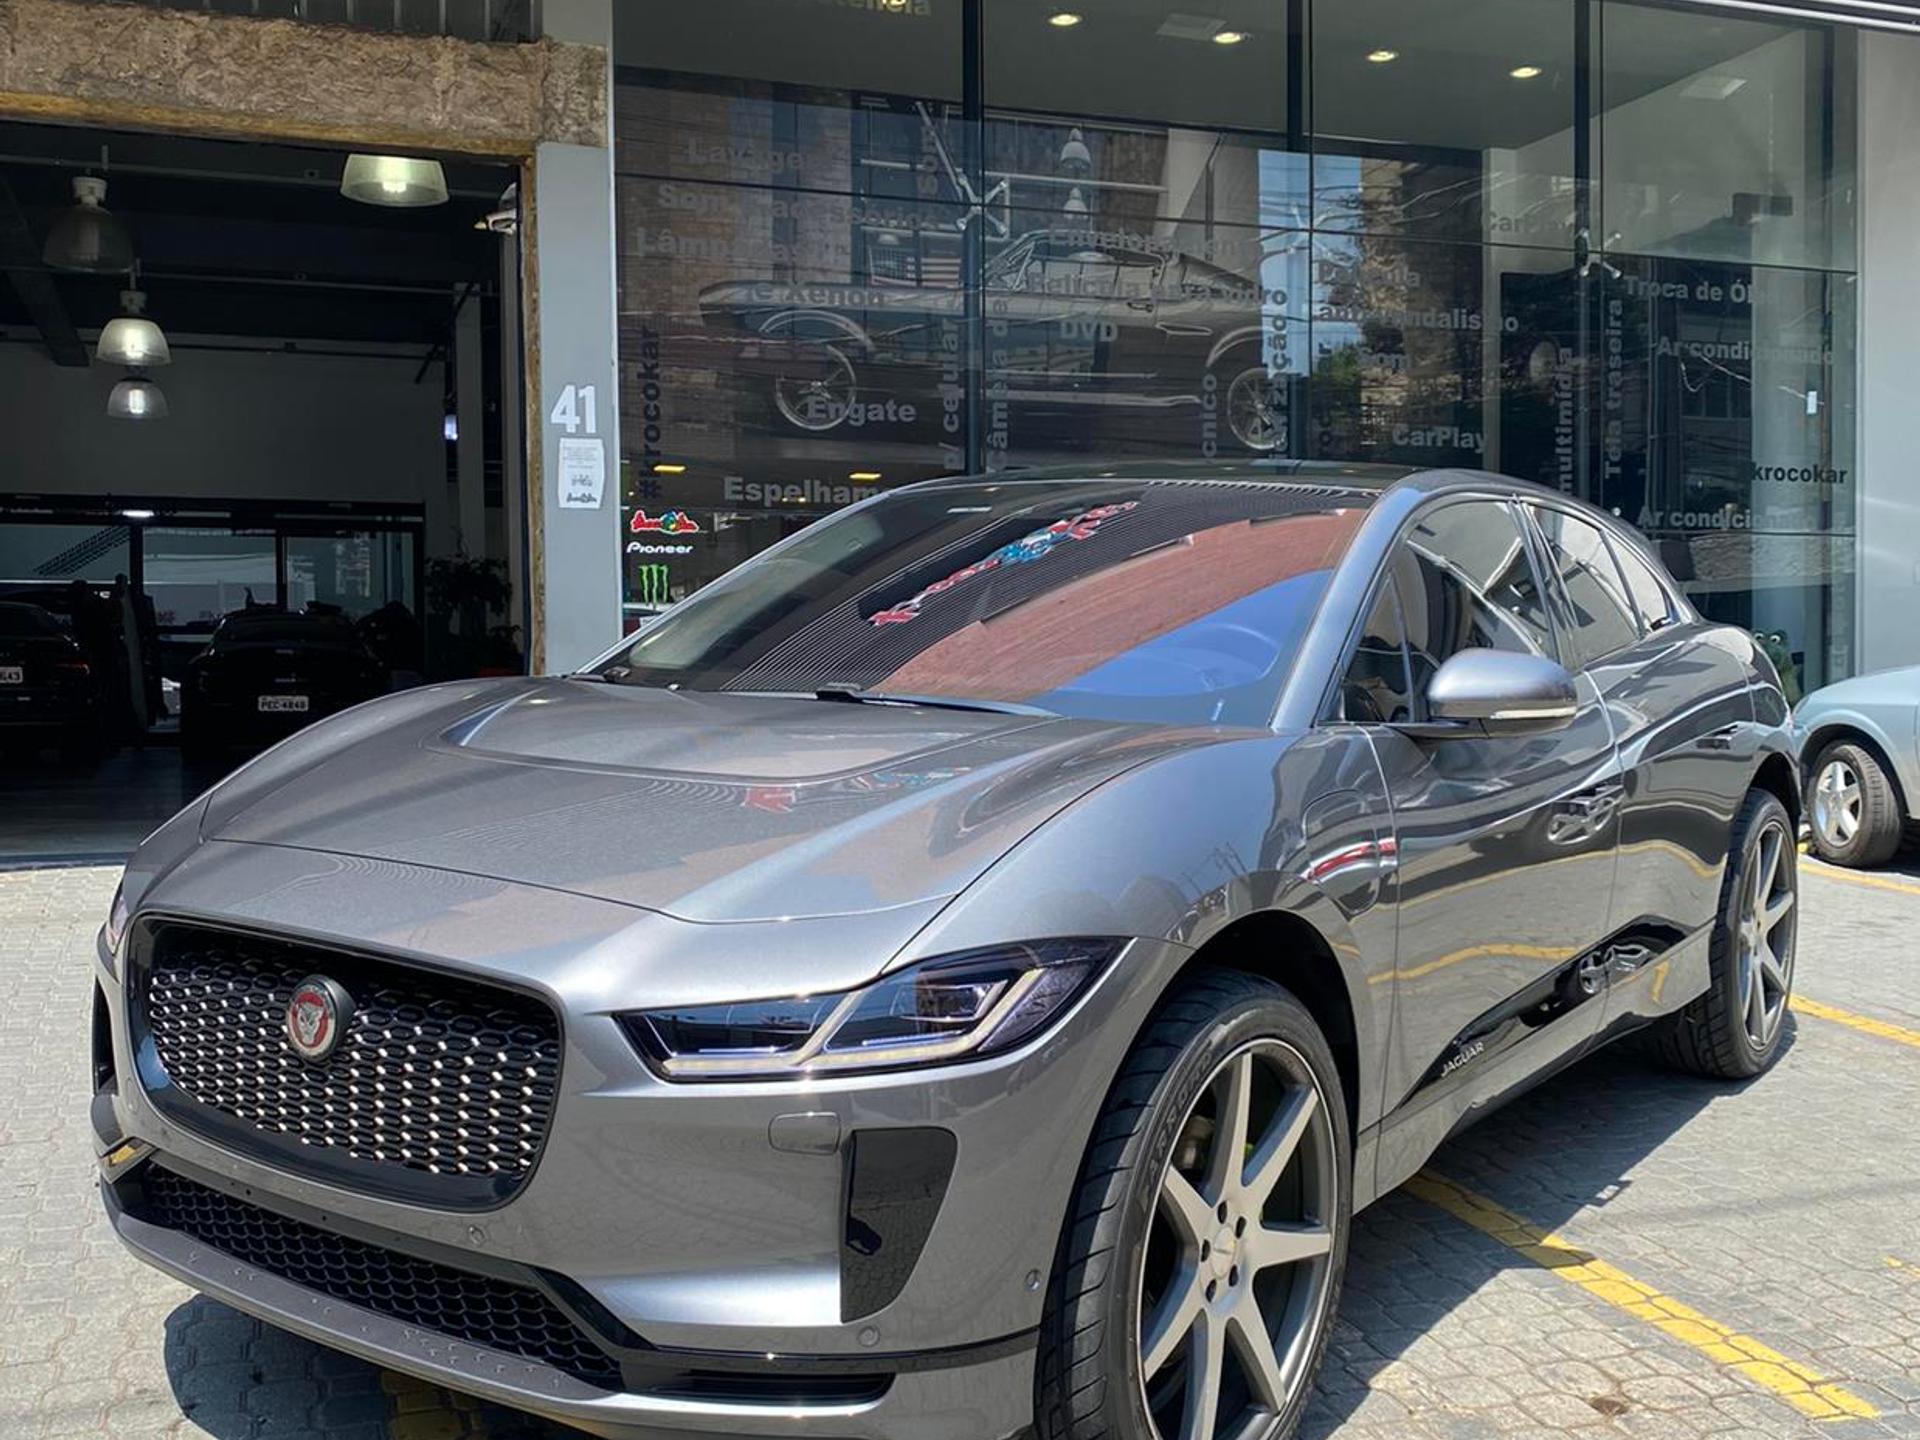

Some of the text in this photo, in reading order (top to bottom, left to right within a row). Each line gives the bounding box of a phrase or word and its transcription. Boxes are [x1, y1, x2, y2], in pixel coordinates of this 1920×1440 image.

[1623, 277, 1689, 300] Troca
[1695, 280, 1724, 302] de
[1060, 320, 1118, 342] DVD
[1604, 299, 1623, 410] traseira
[550, 384, 596, 433] 41
[806, 399, 917, 424] Engate
[1391, 423, 1487, 454] CarPlay
[1637, 504, 1664, 528] Ar
[626, 541, 694, 554] Pioneer
[1441, 1041, 1485, 1078] JAGUAR
